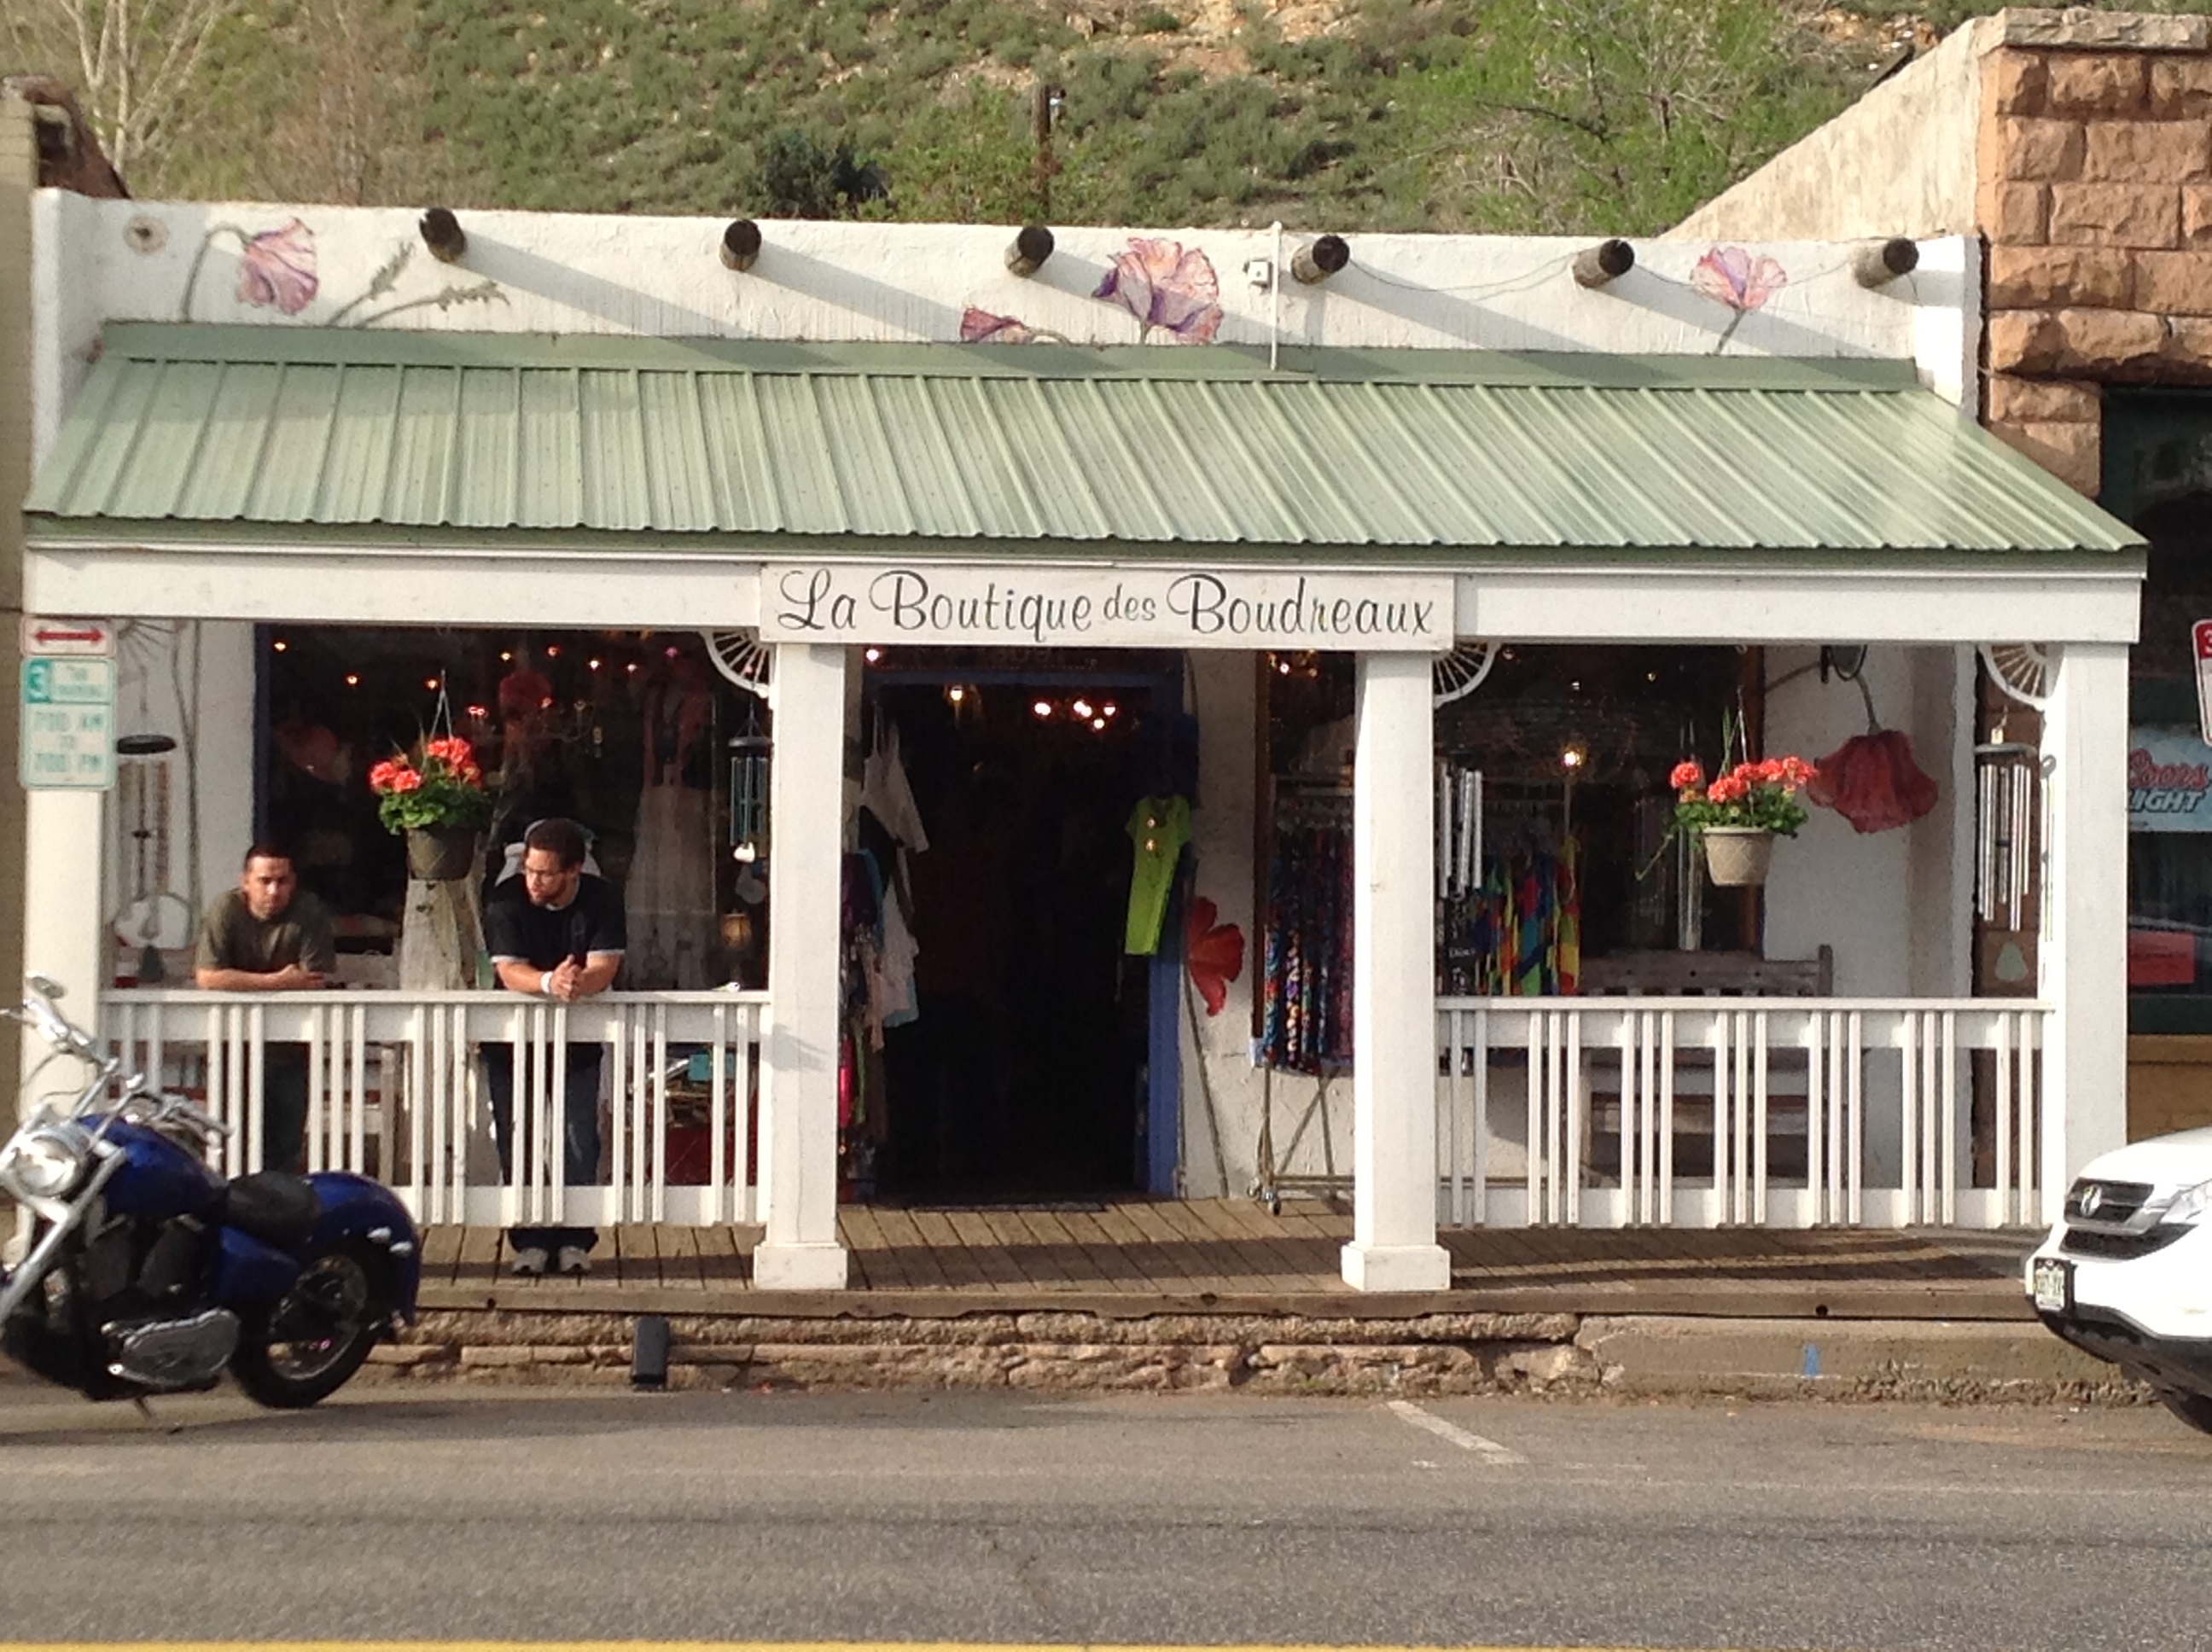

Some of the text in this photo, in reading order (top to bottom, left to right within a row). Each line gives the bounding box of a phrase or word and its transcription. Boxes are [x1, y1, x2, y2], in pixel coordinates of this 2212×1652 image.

[777, 567, 1435, 643] La Boutique des Boudreaux
[30, 666, 50, 698] 3
[2128, 787, 2206, 813] IGHT
